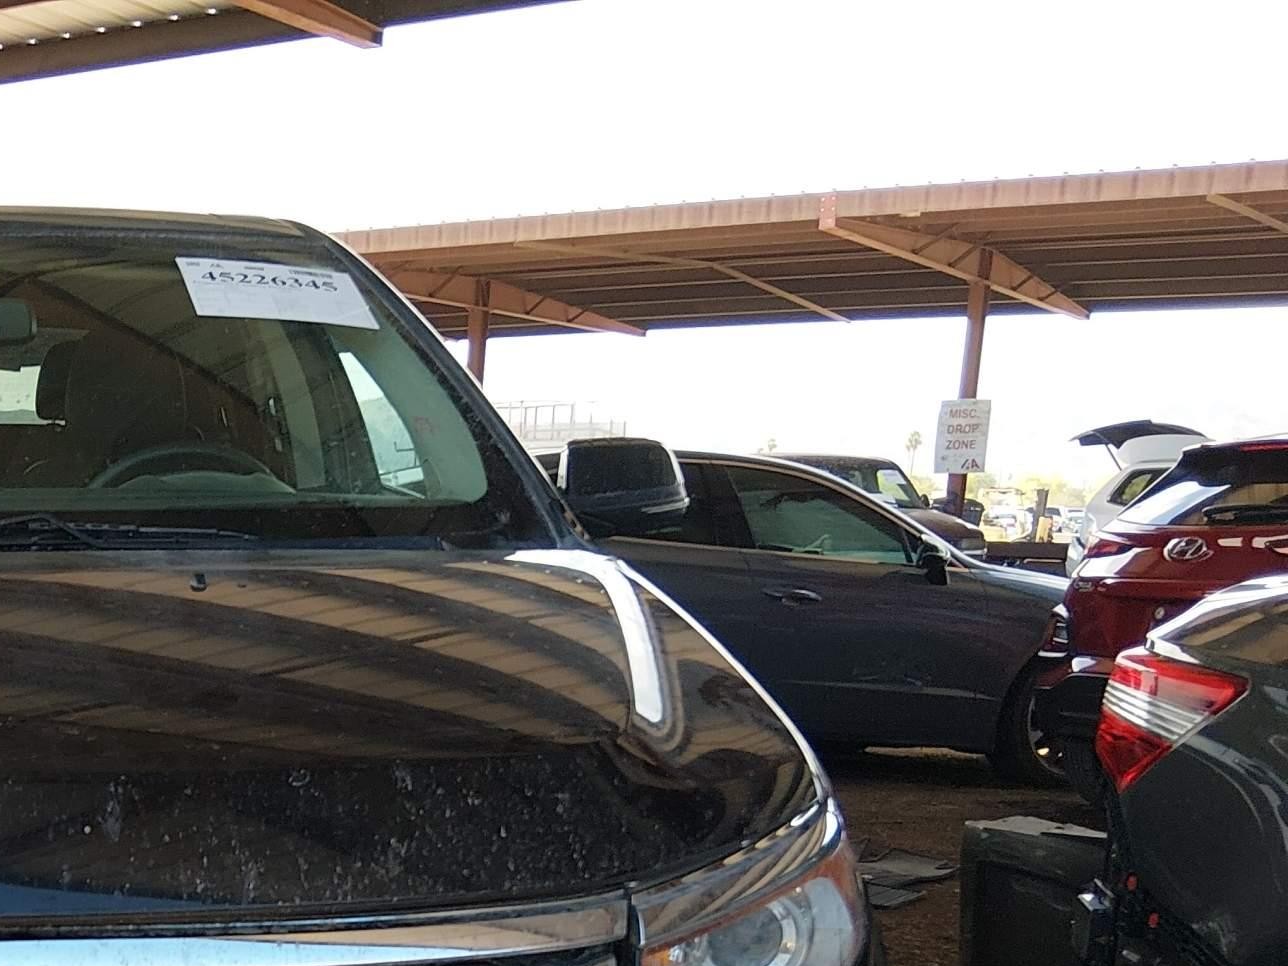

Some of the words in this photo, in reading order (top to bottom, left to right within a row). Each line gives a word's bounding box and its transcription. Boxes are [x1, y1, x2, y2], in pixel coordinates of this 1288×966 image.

[200, 271, 338, 293] 45226345
[946, 423, 980, 435] DROP
[945, 439, 976, 450] ZONE
